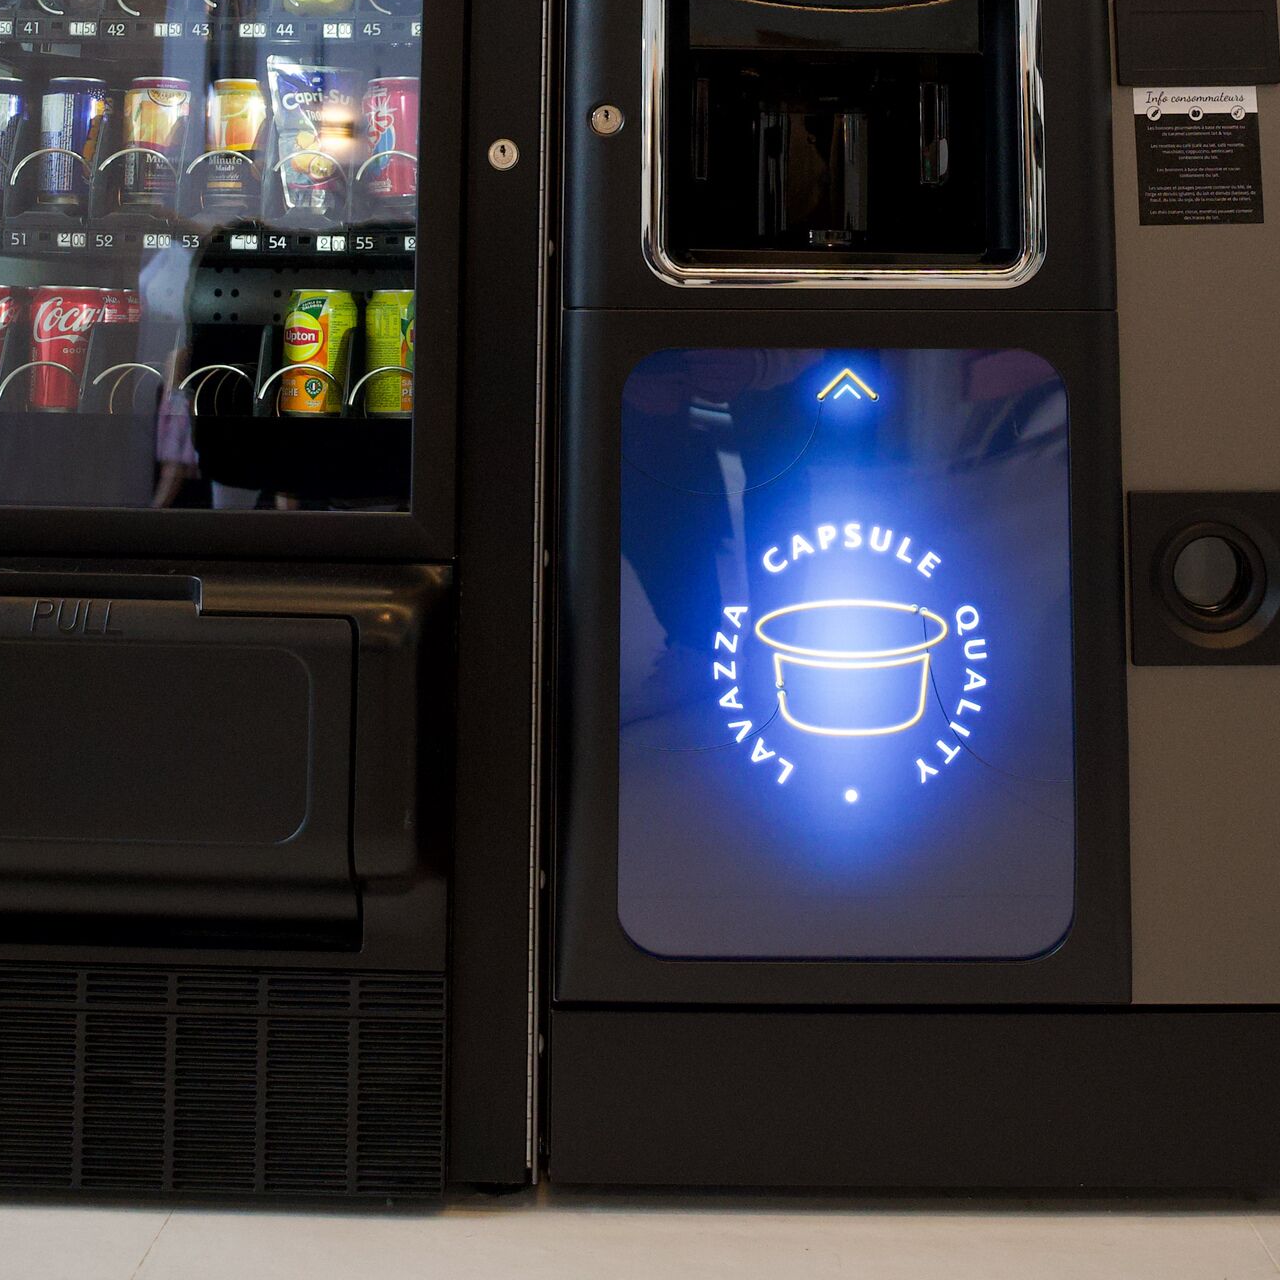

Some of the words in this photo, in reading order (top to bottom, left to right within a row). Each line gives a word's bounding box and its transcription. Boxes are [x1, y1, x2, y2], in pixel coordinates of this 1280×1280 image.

[23, 21, 39, 34] 41
[107, 24, 125, 36] 42
[192, 23, 209, 36] 43
[276, 23, 294, 36] 44
[363, 23, 381, 36] 45
[1145, 90, 1169, 106] Info
[1170, 91, 1246, 104] consommateurs
[208, 156, 243, 165] Minute
[11, 233, 27, 245] 51
[96, 235, 113, 247] 52
[182, 235, 200, 248] 53
[269, 236, 287, 249] 54
[356, 236, 374, 249] 55
[285, 330, 316, 342] Lipton
[761, 522, 942, 579] CAPSULE
[30, 598, 121, 634] PULL
[712, 603, 795, 786] LAVAZZA
[915, 603, 989, 784] QUALITY
